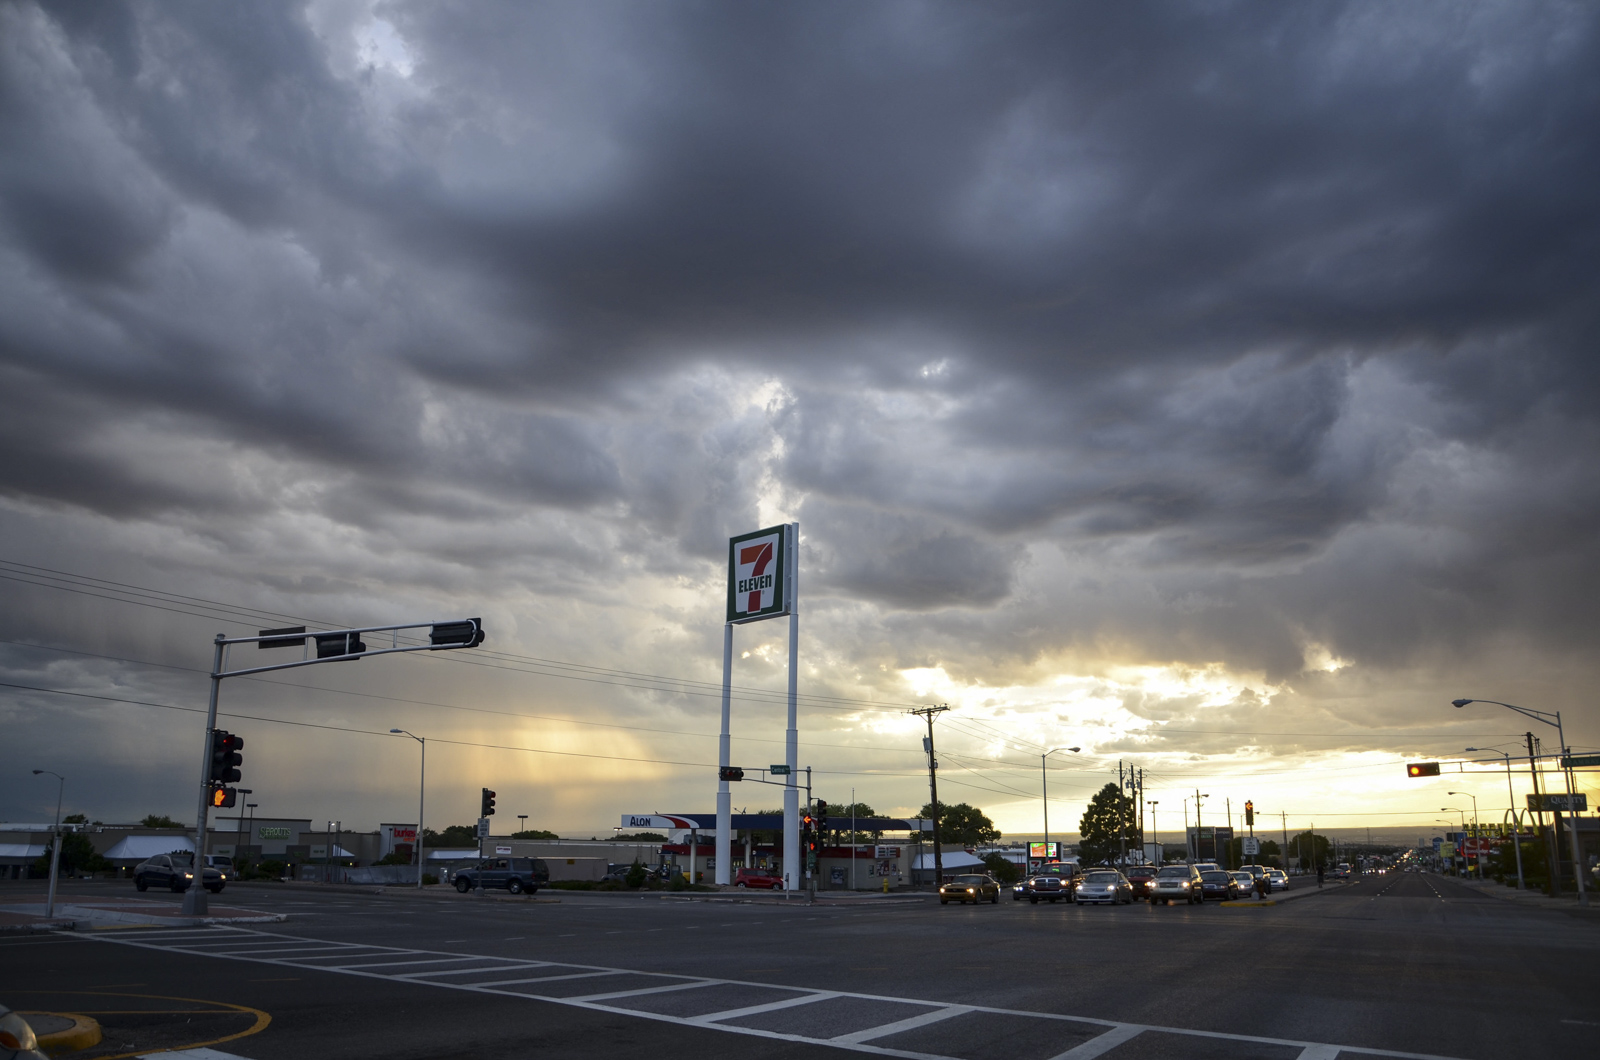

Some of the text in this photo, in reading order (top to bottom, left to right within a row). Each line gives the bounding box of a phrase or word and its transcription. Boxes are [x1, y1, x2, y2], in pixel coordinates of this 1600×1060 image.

[740, 542, 773, 613] 7
[1551, 795, 1584, 804] QUAITY
[630, 816, 651, 827] ALON
[258, 826, 292, 839] SPROUTS
[393, 827, 416, 837] burkes
